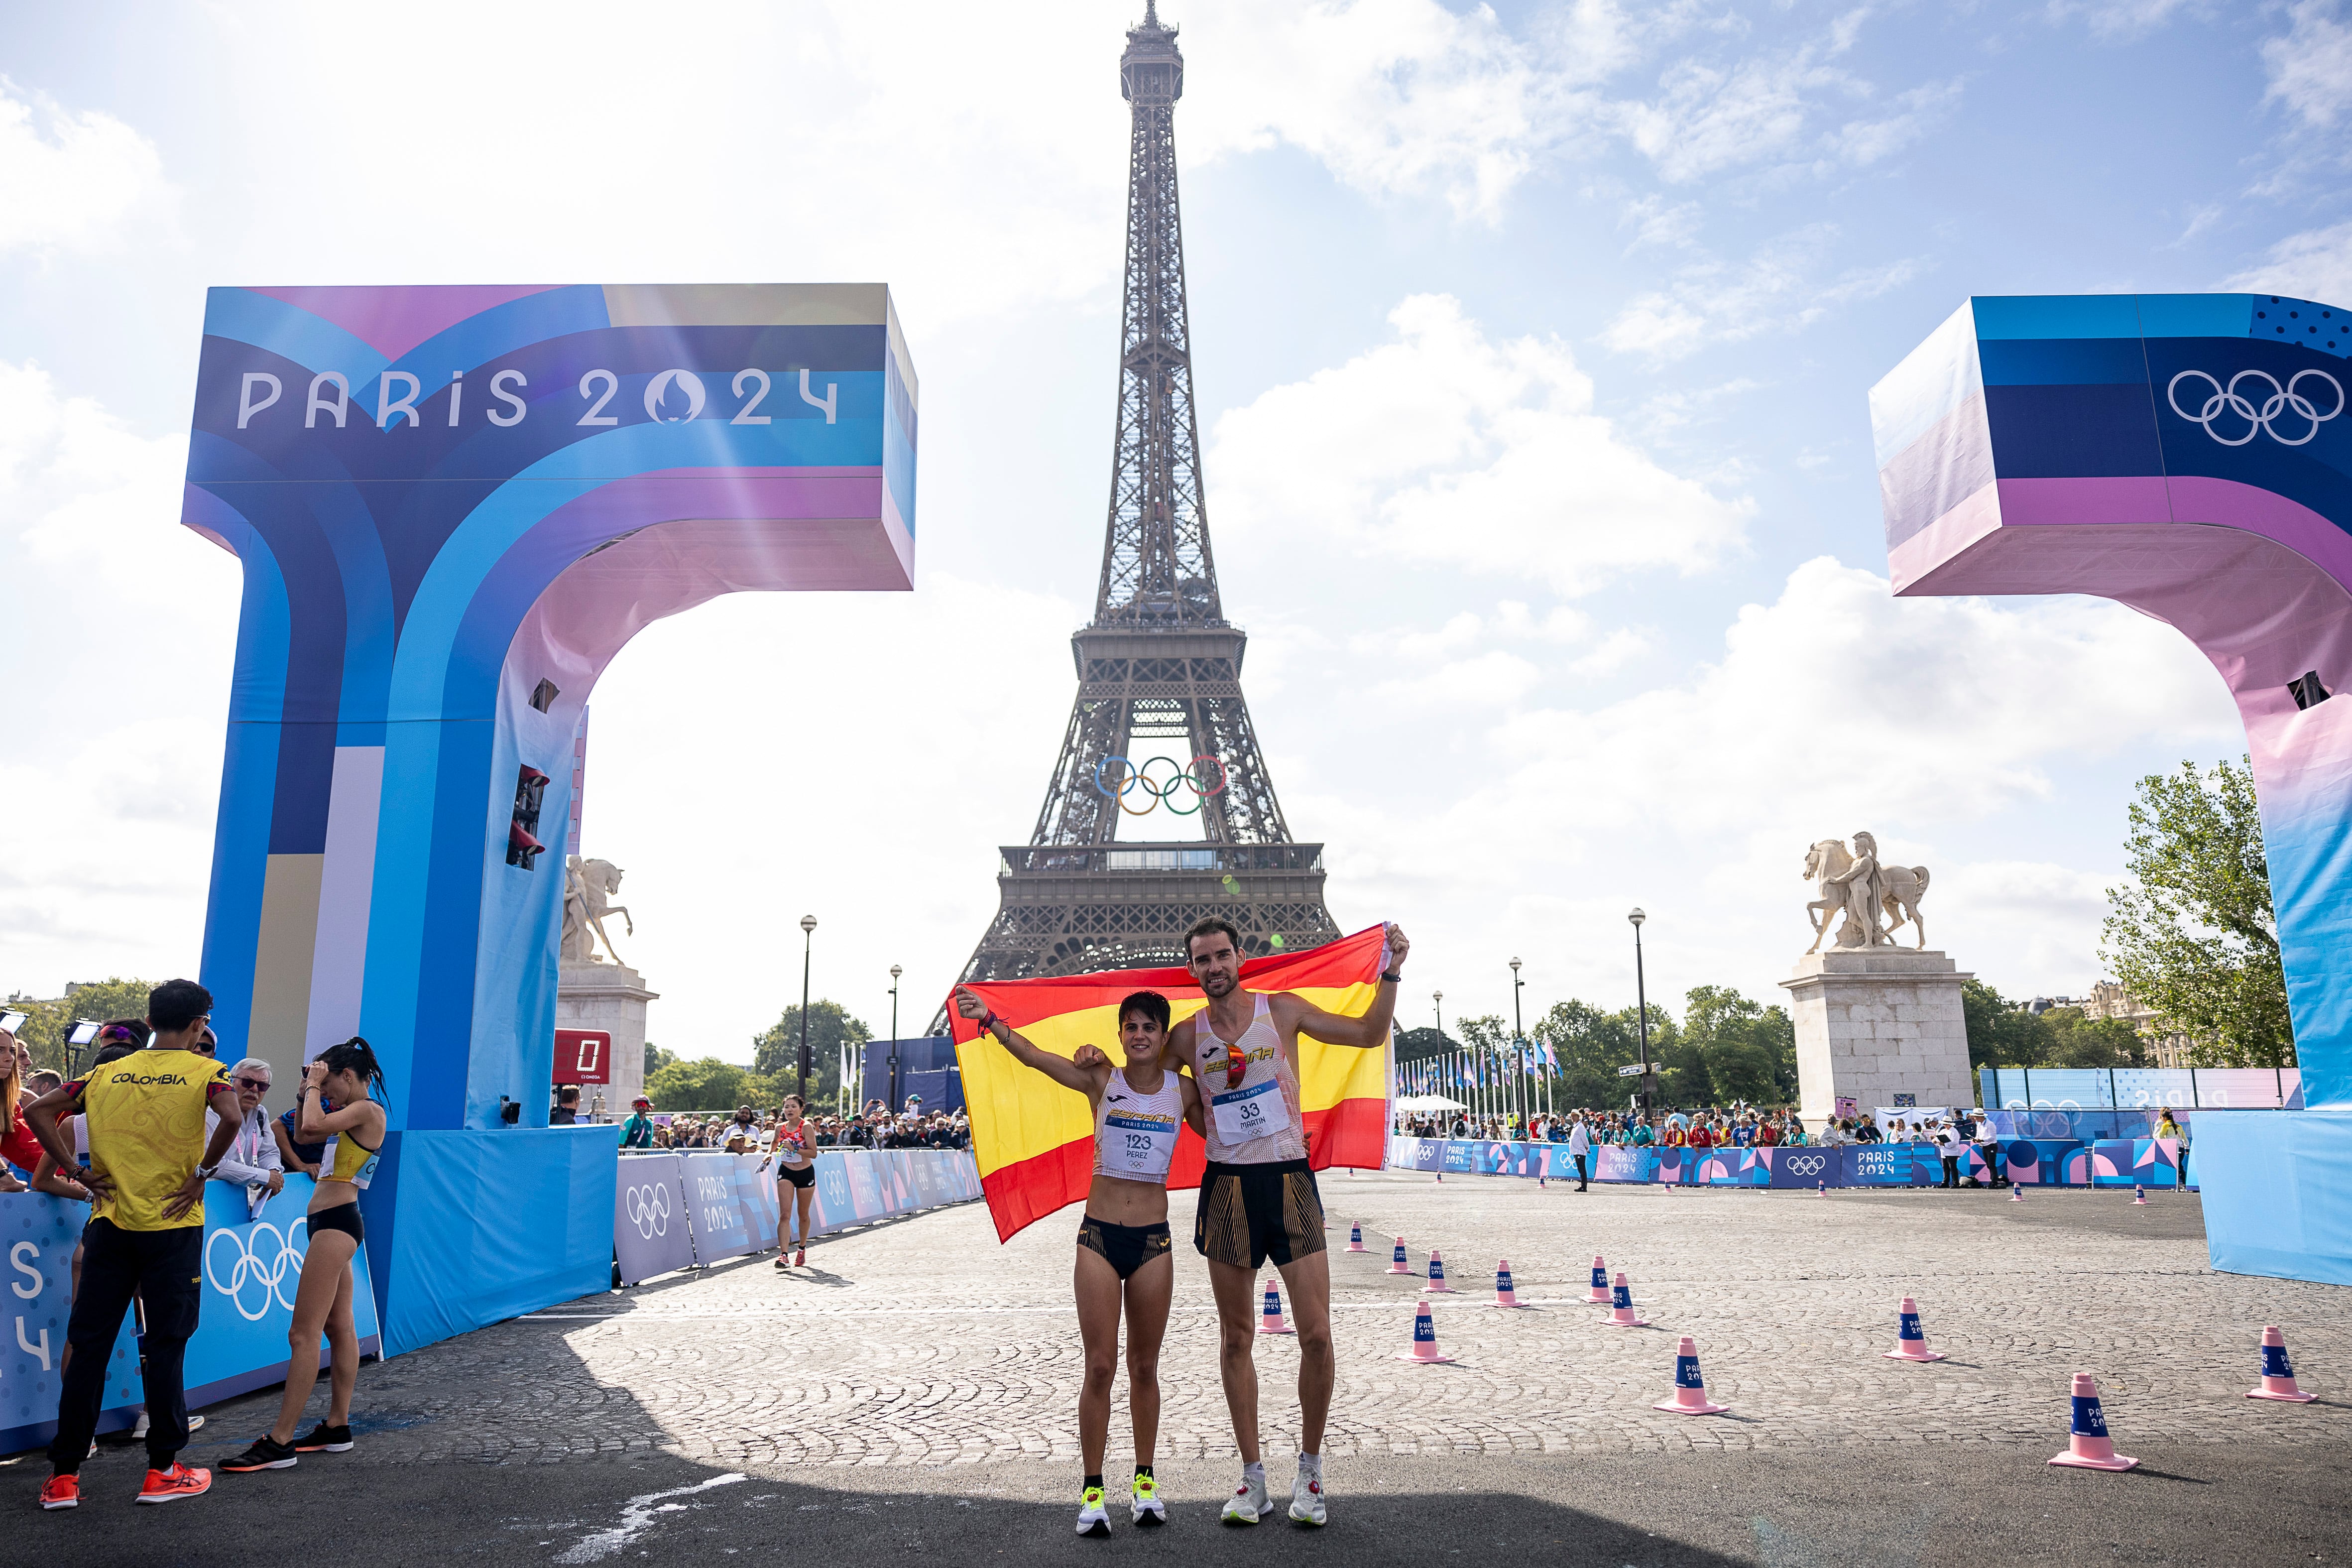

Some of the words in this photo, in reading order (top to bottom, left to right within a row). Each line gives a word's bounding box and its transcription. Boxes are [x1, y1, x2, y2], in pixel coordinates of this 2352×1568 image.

[577, 368, 838, 426] 2024
[1204, 1047, 1274, 1074] ESAÑA
[112, 1073, 187, 1085] COLOMBIA
[1108, 1108, 1176, 1124] ESPAÑA
[1240, 1102, 1260, 1119] 33
[1240, 1116, 1266, 1129] MARTIN
[1125, 1134, 1152, 1150] 123
[1126, 1151, 1148, 1159] PEREZ
[1445, 1155, 1464, 1164] 2024
[1608, 1164, 1636, 1173] 2024
[1858, 1164, 1894, 1175] 2024
[704, 1205, 733, 1232] 2024
